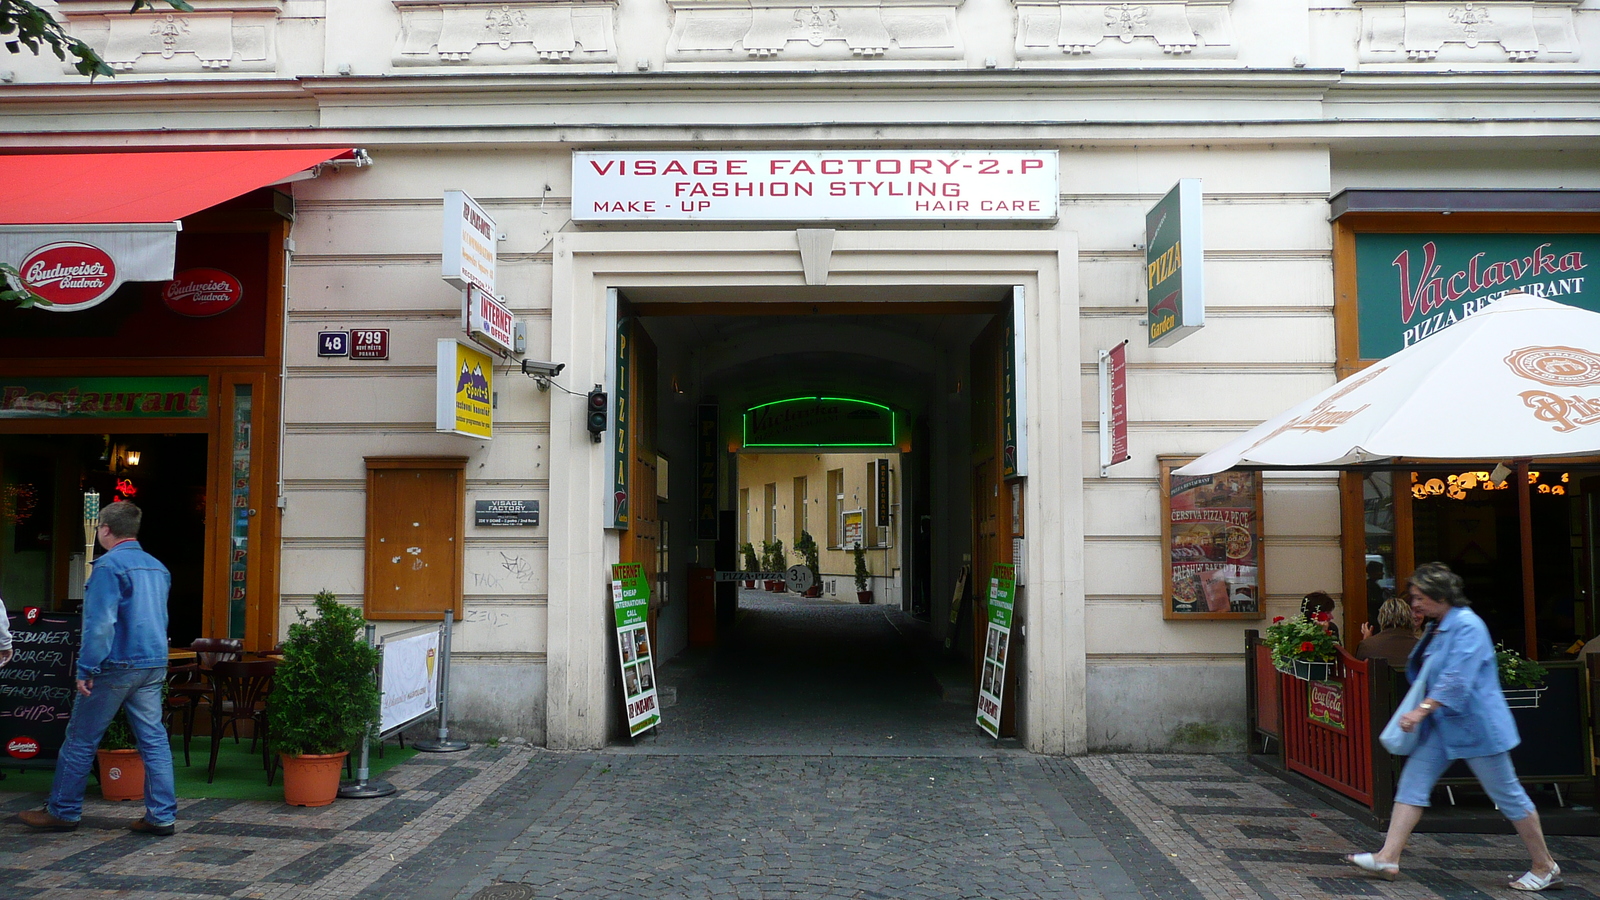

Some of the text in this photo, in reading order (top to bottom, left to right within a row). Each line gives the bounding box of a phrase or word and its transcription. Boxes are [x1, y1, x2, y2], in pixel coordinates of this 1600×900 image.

[589, 159, 748, 176] VISAGE
[674, 181, 961, 197] FASHION STYLING
[594, 200, 656, 213] MAKE
[681, 200, 711, 212] UP
[915, 200, 1041, 212] HAIR CARE
[26, 259, 109, 287] Budweiser
[1148, 240, 1182, 291] PIZZA
[59, 276, 105, 289] Budvar
[167, 279, 234, 301] Budweiser
[1391, 240, 1589, 325] Václavka
[192, 291, 231, 303] Budvar
[480, 296, 512, 336] INTERNET
[1403, 277, 1585, 350] PIZZA RESTURANT
[490, 326, 510, 346] OFFICE
[1150, 314, 1175, 340] Garden
[325, 336, 342, 351] 48
[357, 331, 382, 345] 799
[1004, 327, 1013, 442] PIZZA
[2, 384, 204, 413] Restaurant
[618, 333, 627, 485] PIZZA
[700, 419, 715, 520] PIZZA
[1203, 510, 1224, 522] PIZZA
[1225, 510, 1230, 523] Z
[1231, 511, 1250, 530] PECE
[233, 550, 247, 600] Pub
[613, 564, 641, 580] INTERNET
[623, 588, 637, 598] CHEAP
[615, 598, 647, 609] INTERNATIONAL
[626, 609, 638, 617] CALL
[12, 648, 67, 668] BURGER
[1311, 686, 1342, 712] Coca-Cola
[14, 704, 56, 723] CHIPS
